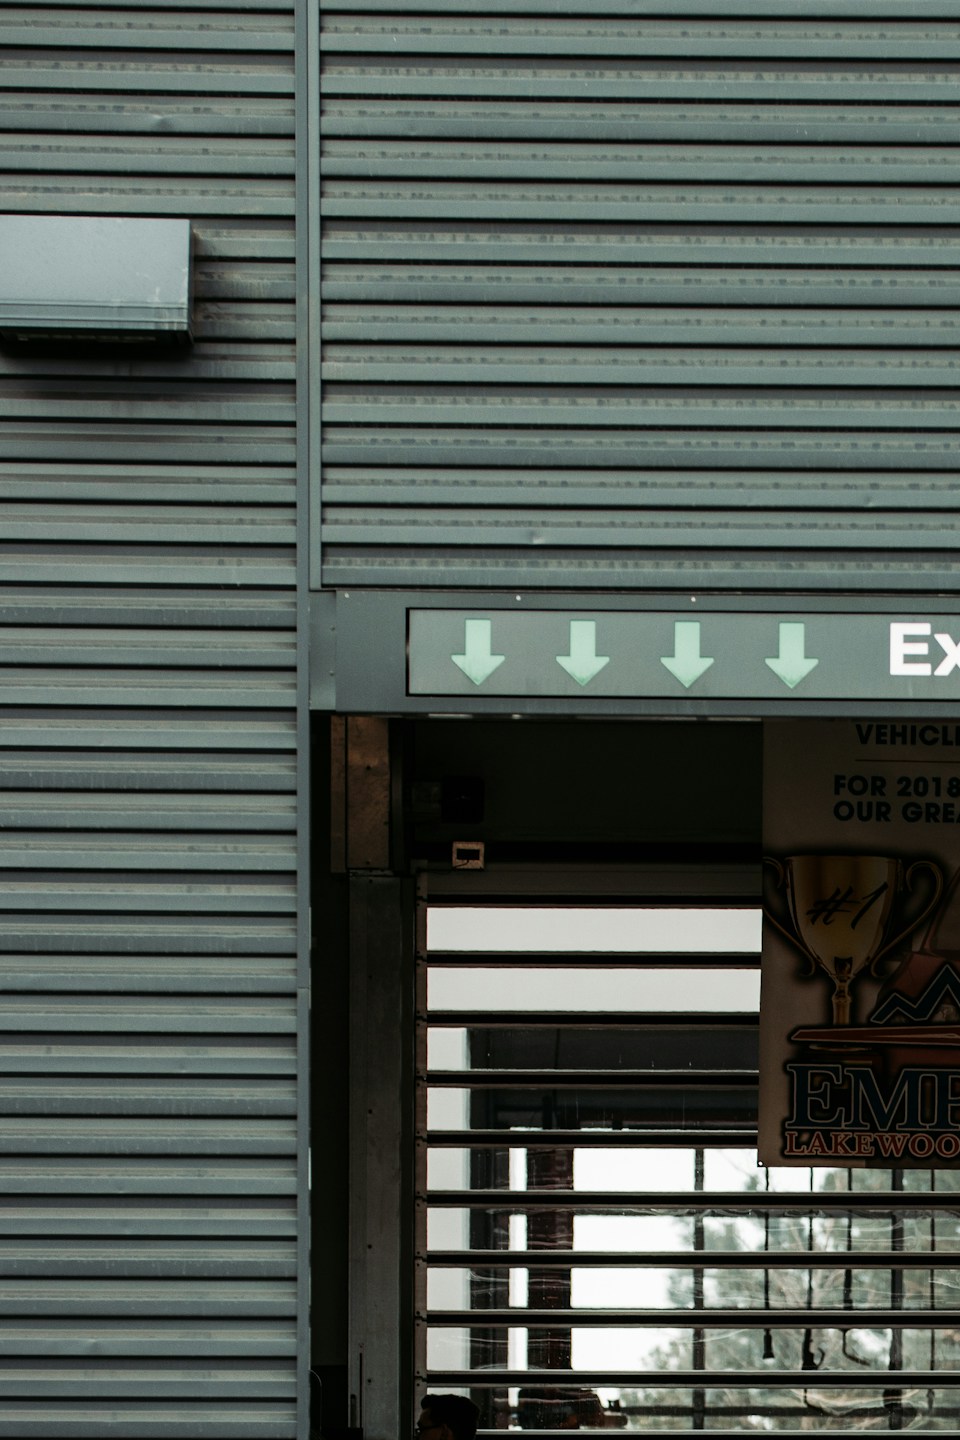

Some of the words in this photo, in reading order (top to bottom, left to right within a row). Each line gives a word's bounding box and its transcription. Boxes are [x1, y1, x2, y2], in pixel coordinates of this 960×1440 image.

[834, 775, 887, 797] FOR
[833, 801, 891, 823] OUR
[807, 883, 889, 929] #1
